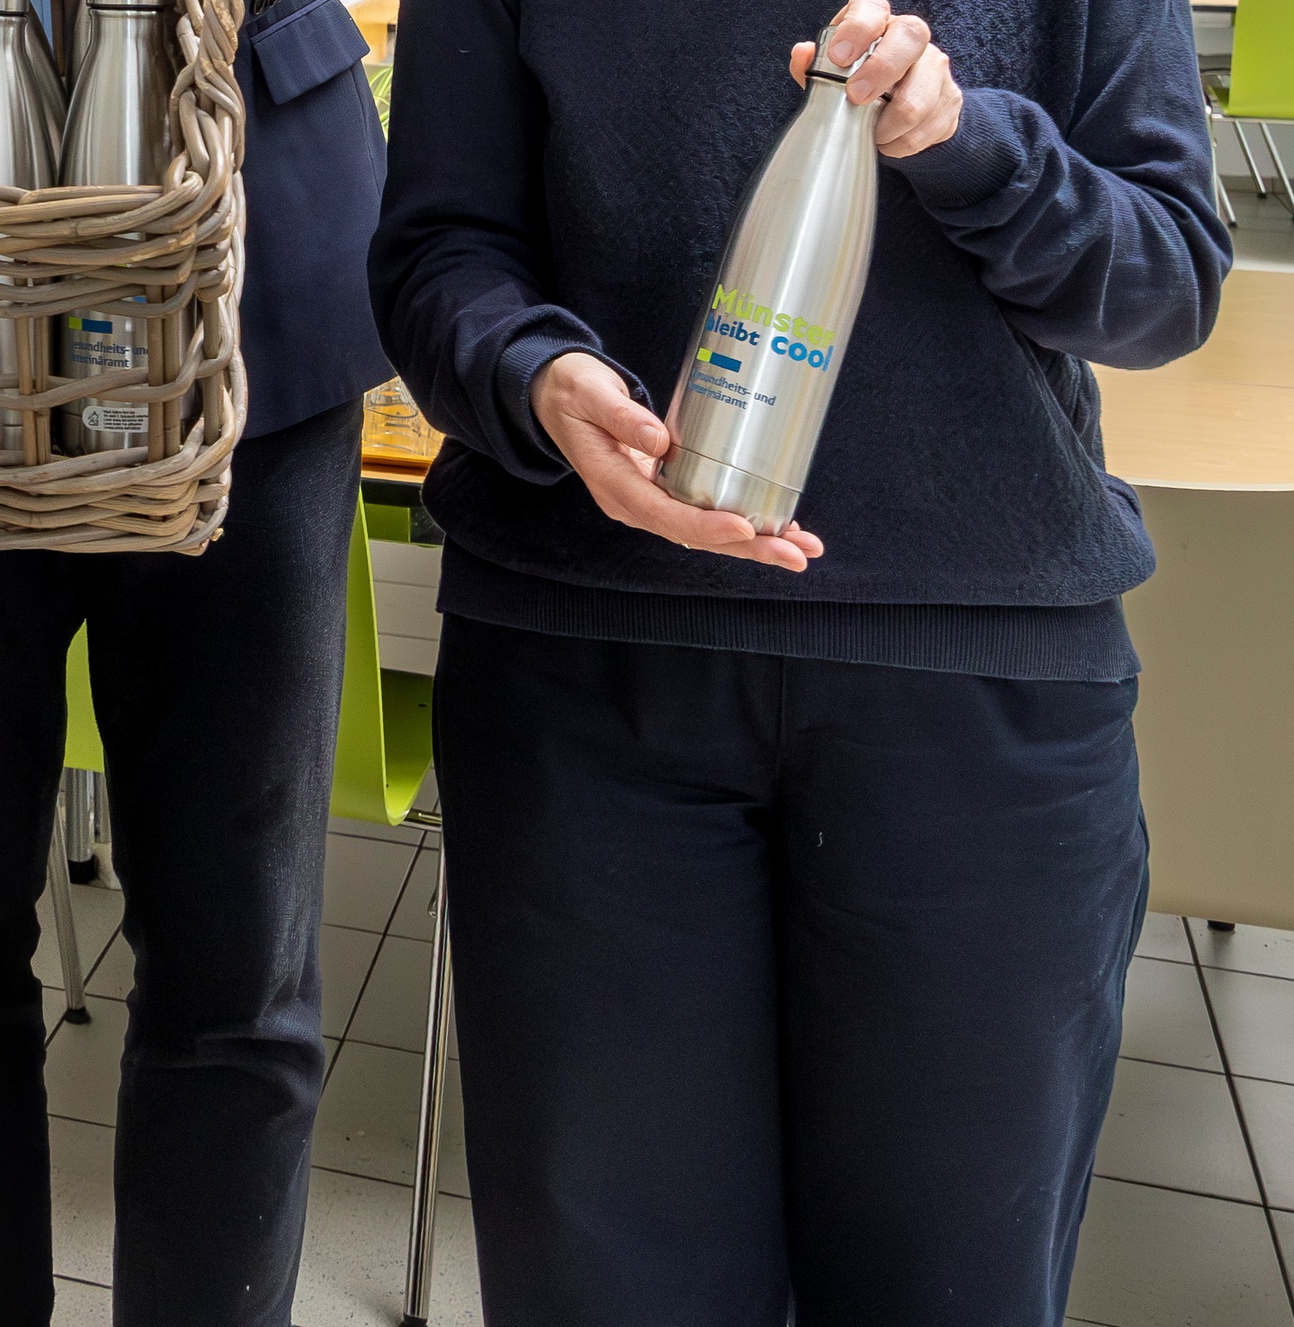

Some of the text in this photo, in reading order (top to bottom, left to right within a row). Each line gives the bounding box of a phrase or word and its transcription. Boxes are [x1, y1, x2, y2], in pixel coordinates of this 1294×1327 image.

[712, 284, 836, 349] Münster
[133, 346, 148, 356] un
[771, 335, 834, 372] cool
[754, 392, 777, 406] und
